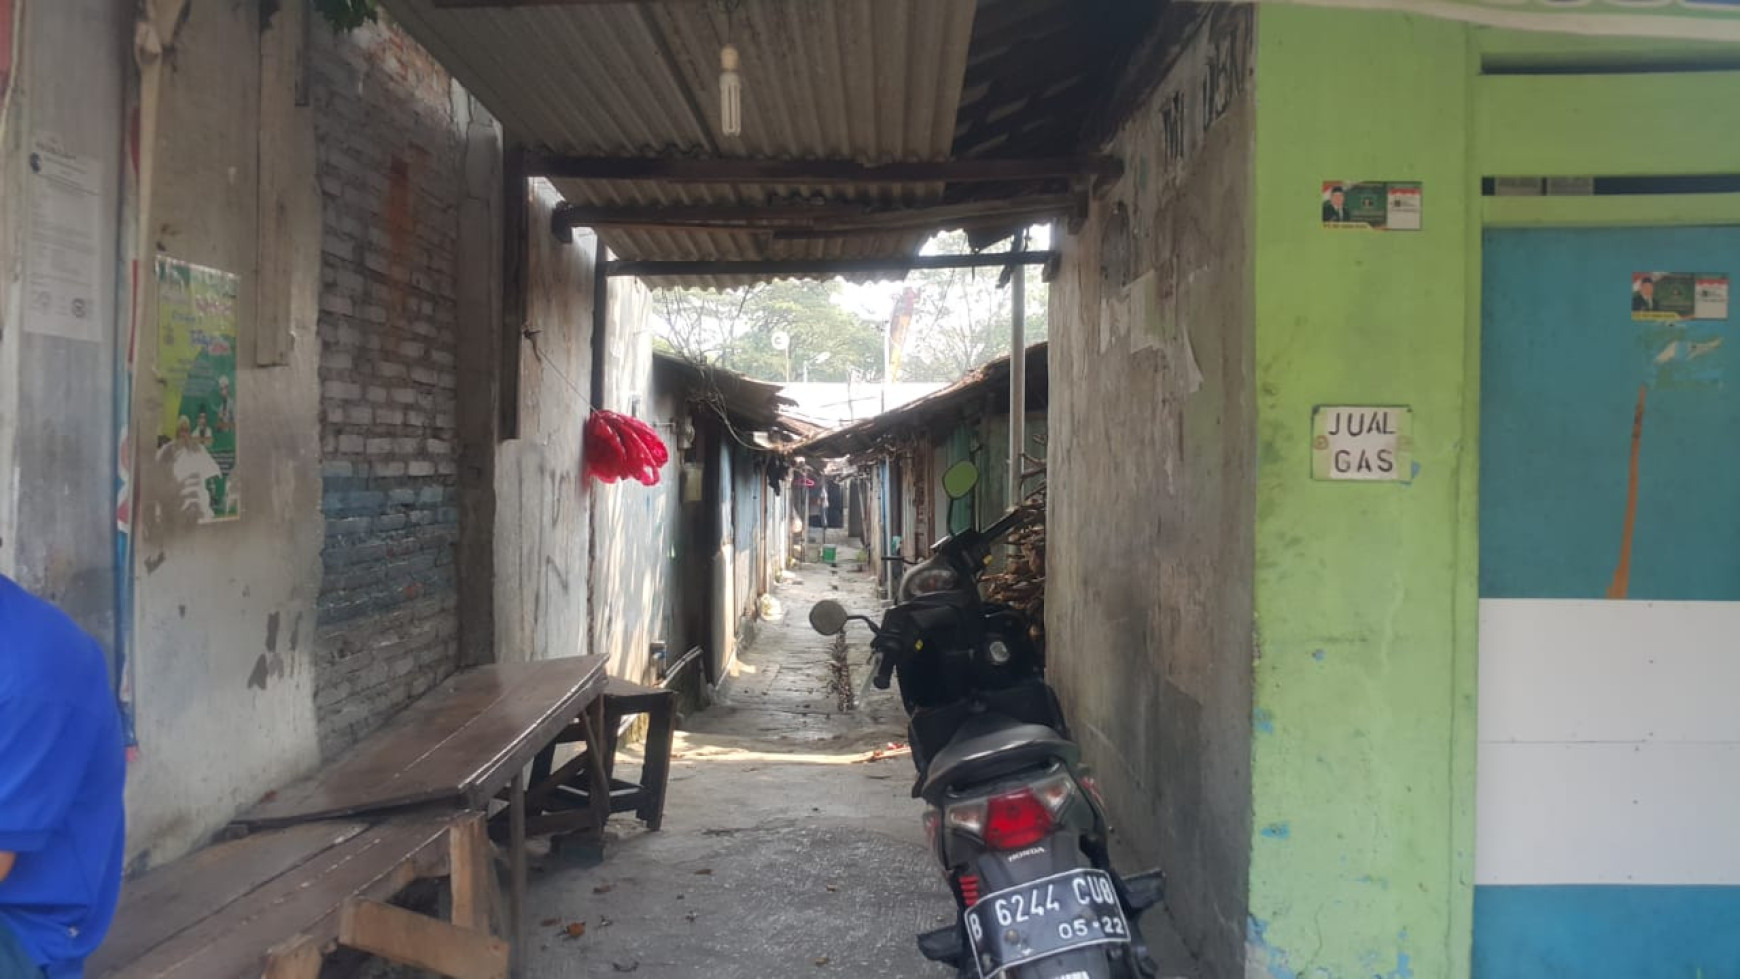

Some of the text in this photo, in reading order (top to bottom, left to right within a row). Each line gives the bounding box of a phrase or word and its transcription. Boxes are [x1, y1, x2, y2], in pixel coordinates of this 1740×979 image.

[1328, 411, 1397, 437] JUAL
[1334, 449, 1394, 473] GAS
[1008, 847, 1045, 862] HONDA
[968, 876, 1115, 941] B 6244 CUB
